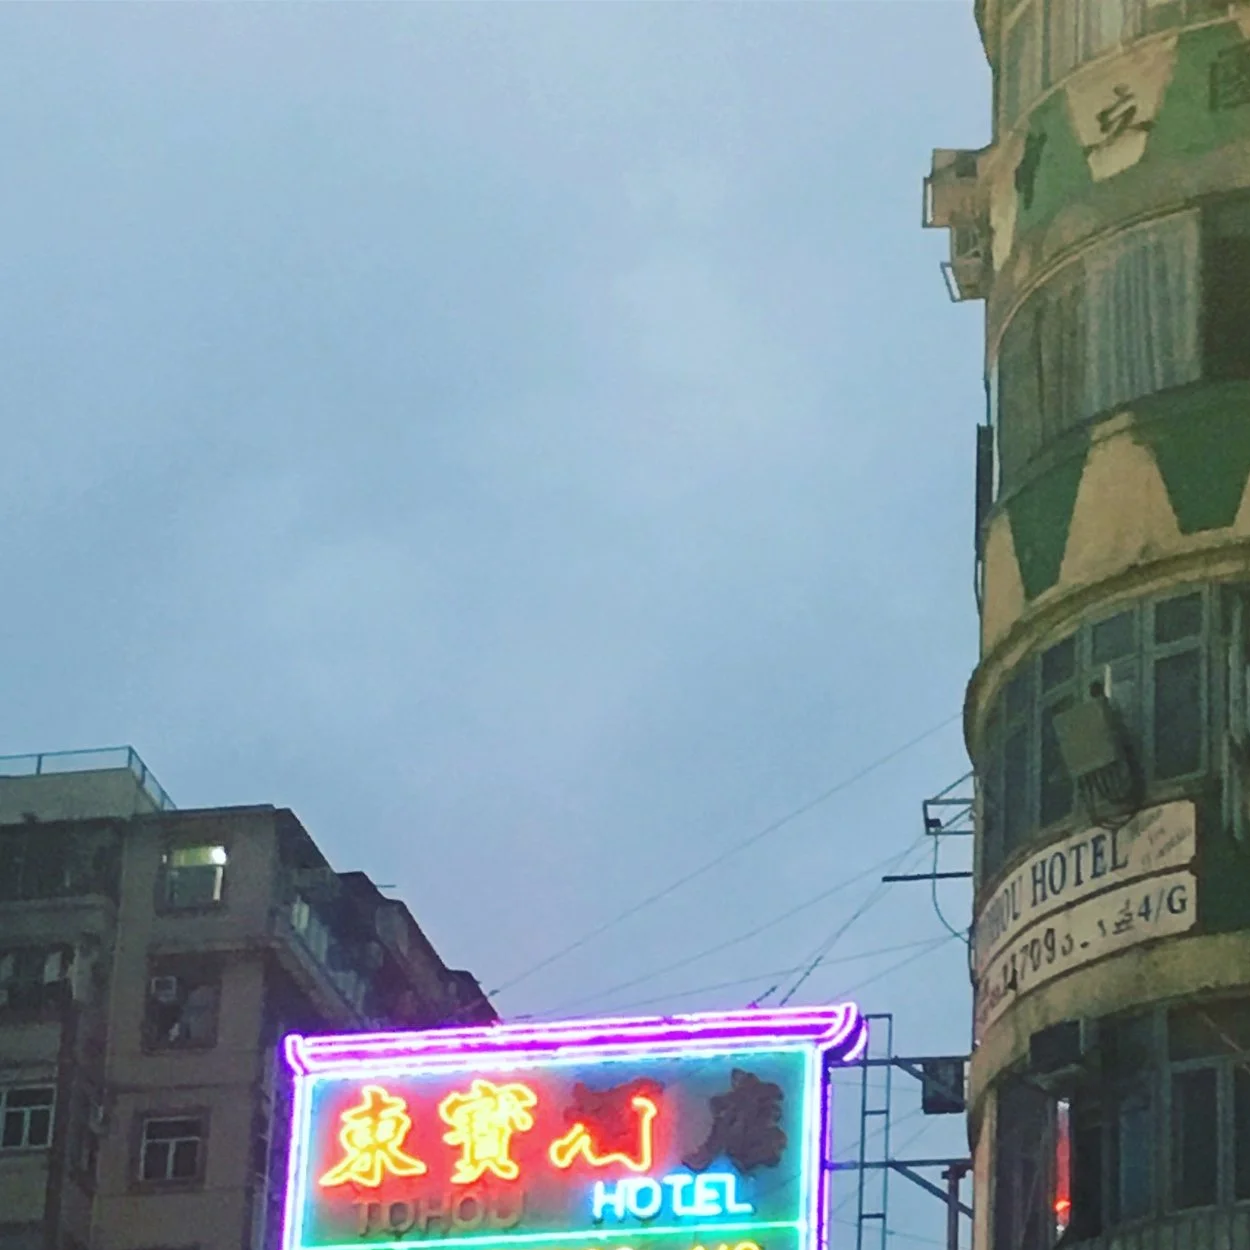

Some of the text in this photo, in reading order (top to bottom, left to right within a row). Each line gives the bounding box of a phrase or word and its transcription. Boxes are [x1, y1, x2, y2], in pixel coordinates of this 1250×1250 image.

[1030, 830, 1128, 908] HOTEL
[1137, 885, 1188, 924] 4/G
[352, 1189, 526, 1237] TOHOU
[592, 1172, 755, 1219] HOTEL
